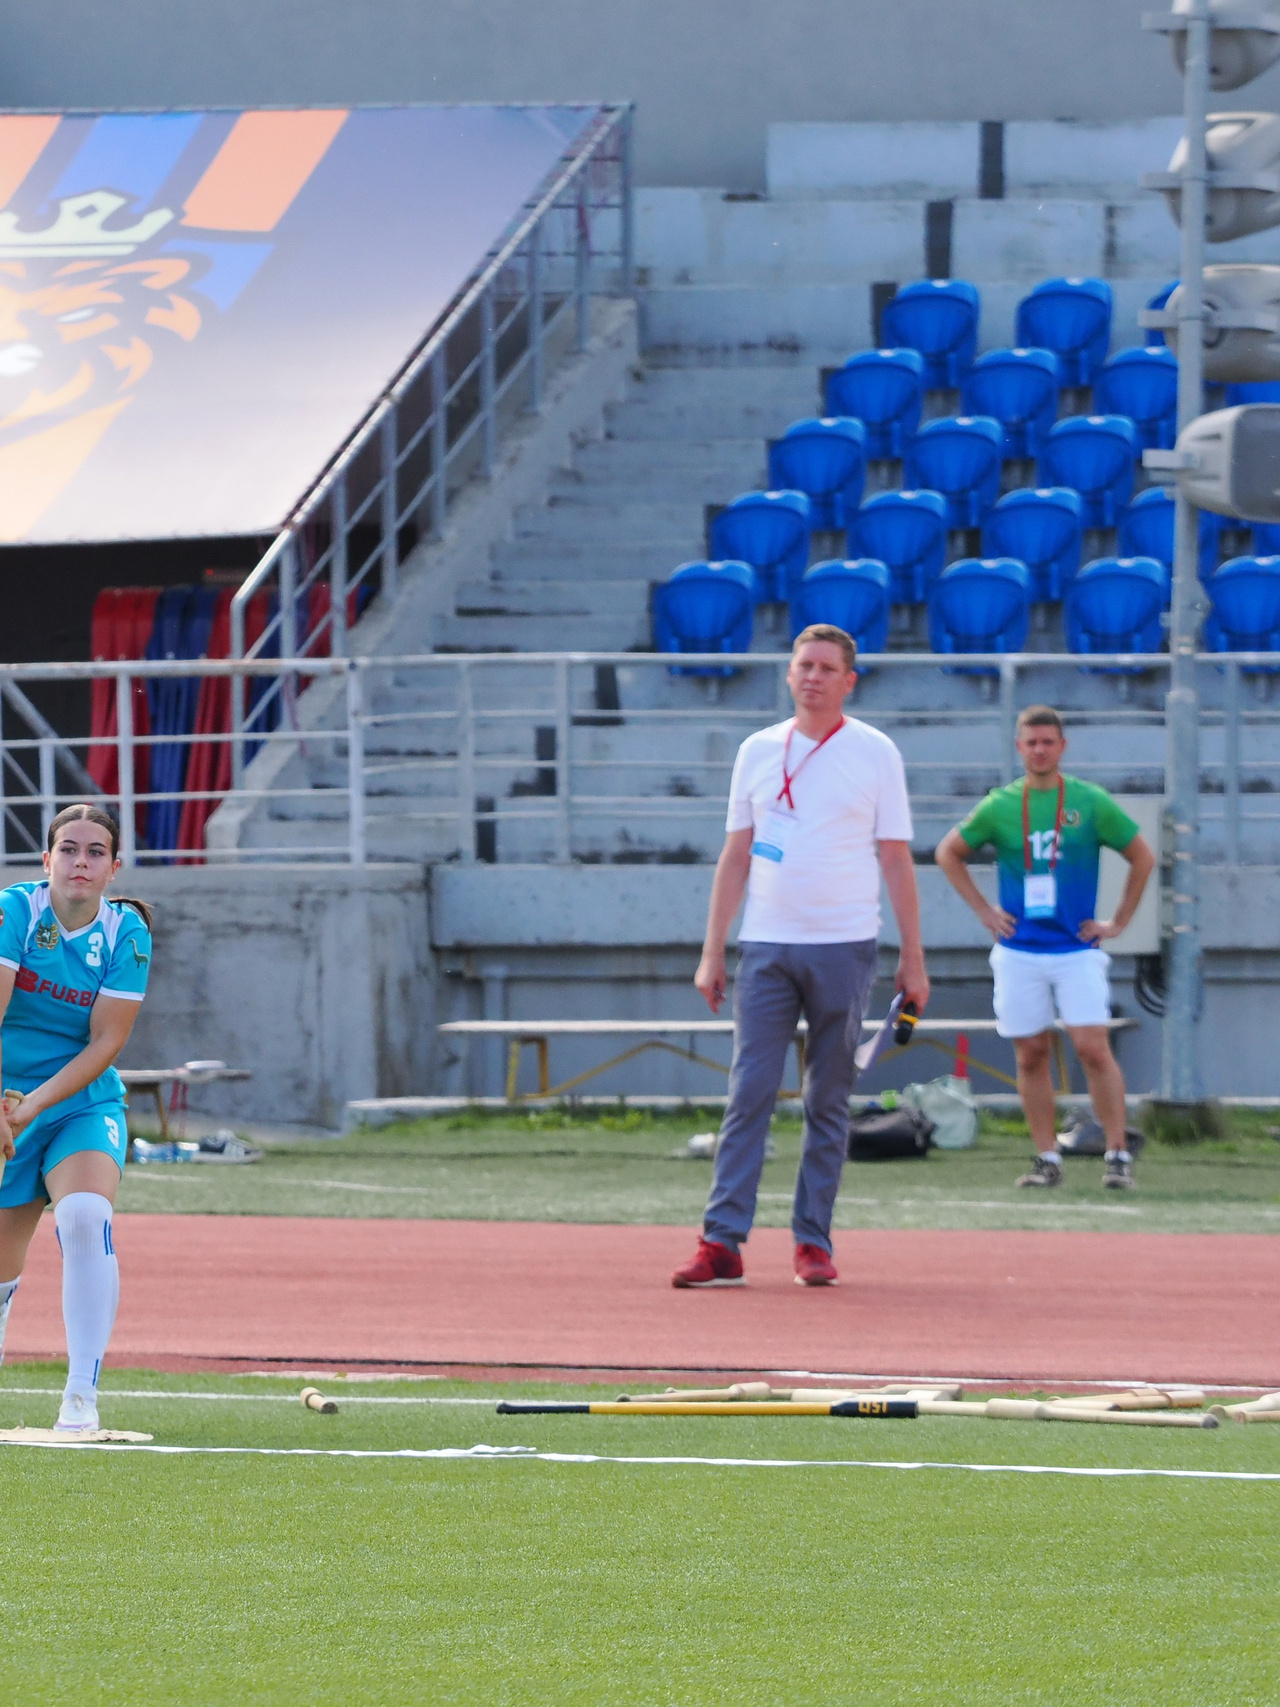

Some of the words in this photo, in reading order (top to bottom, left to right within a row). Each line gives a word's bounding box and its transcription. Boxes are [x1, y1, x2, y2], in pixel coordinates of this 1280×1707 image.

[1027, 829, 1064, 861] 12
[86, 931, 104, 967] 3
[104, 1115, 119, 1148] 3
